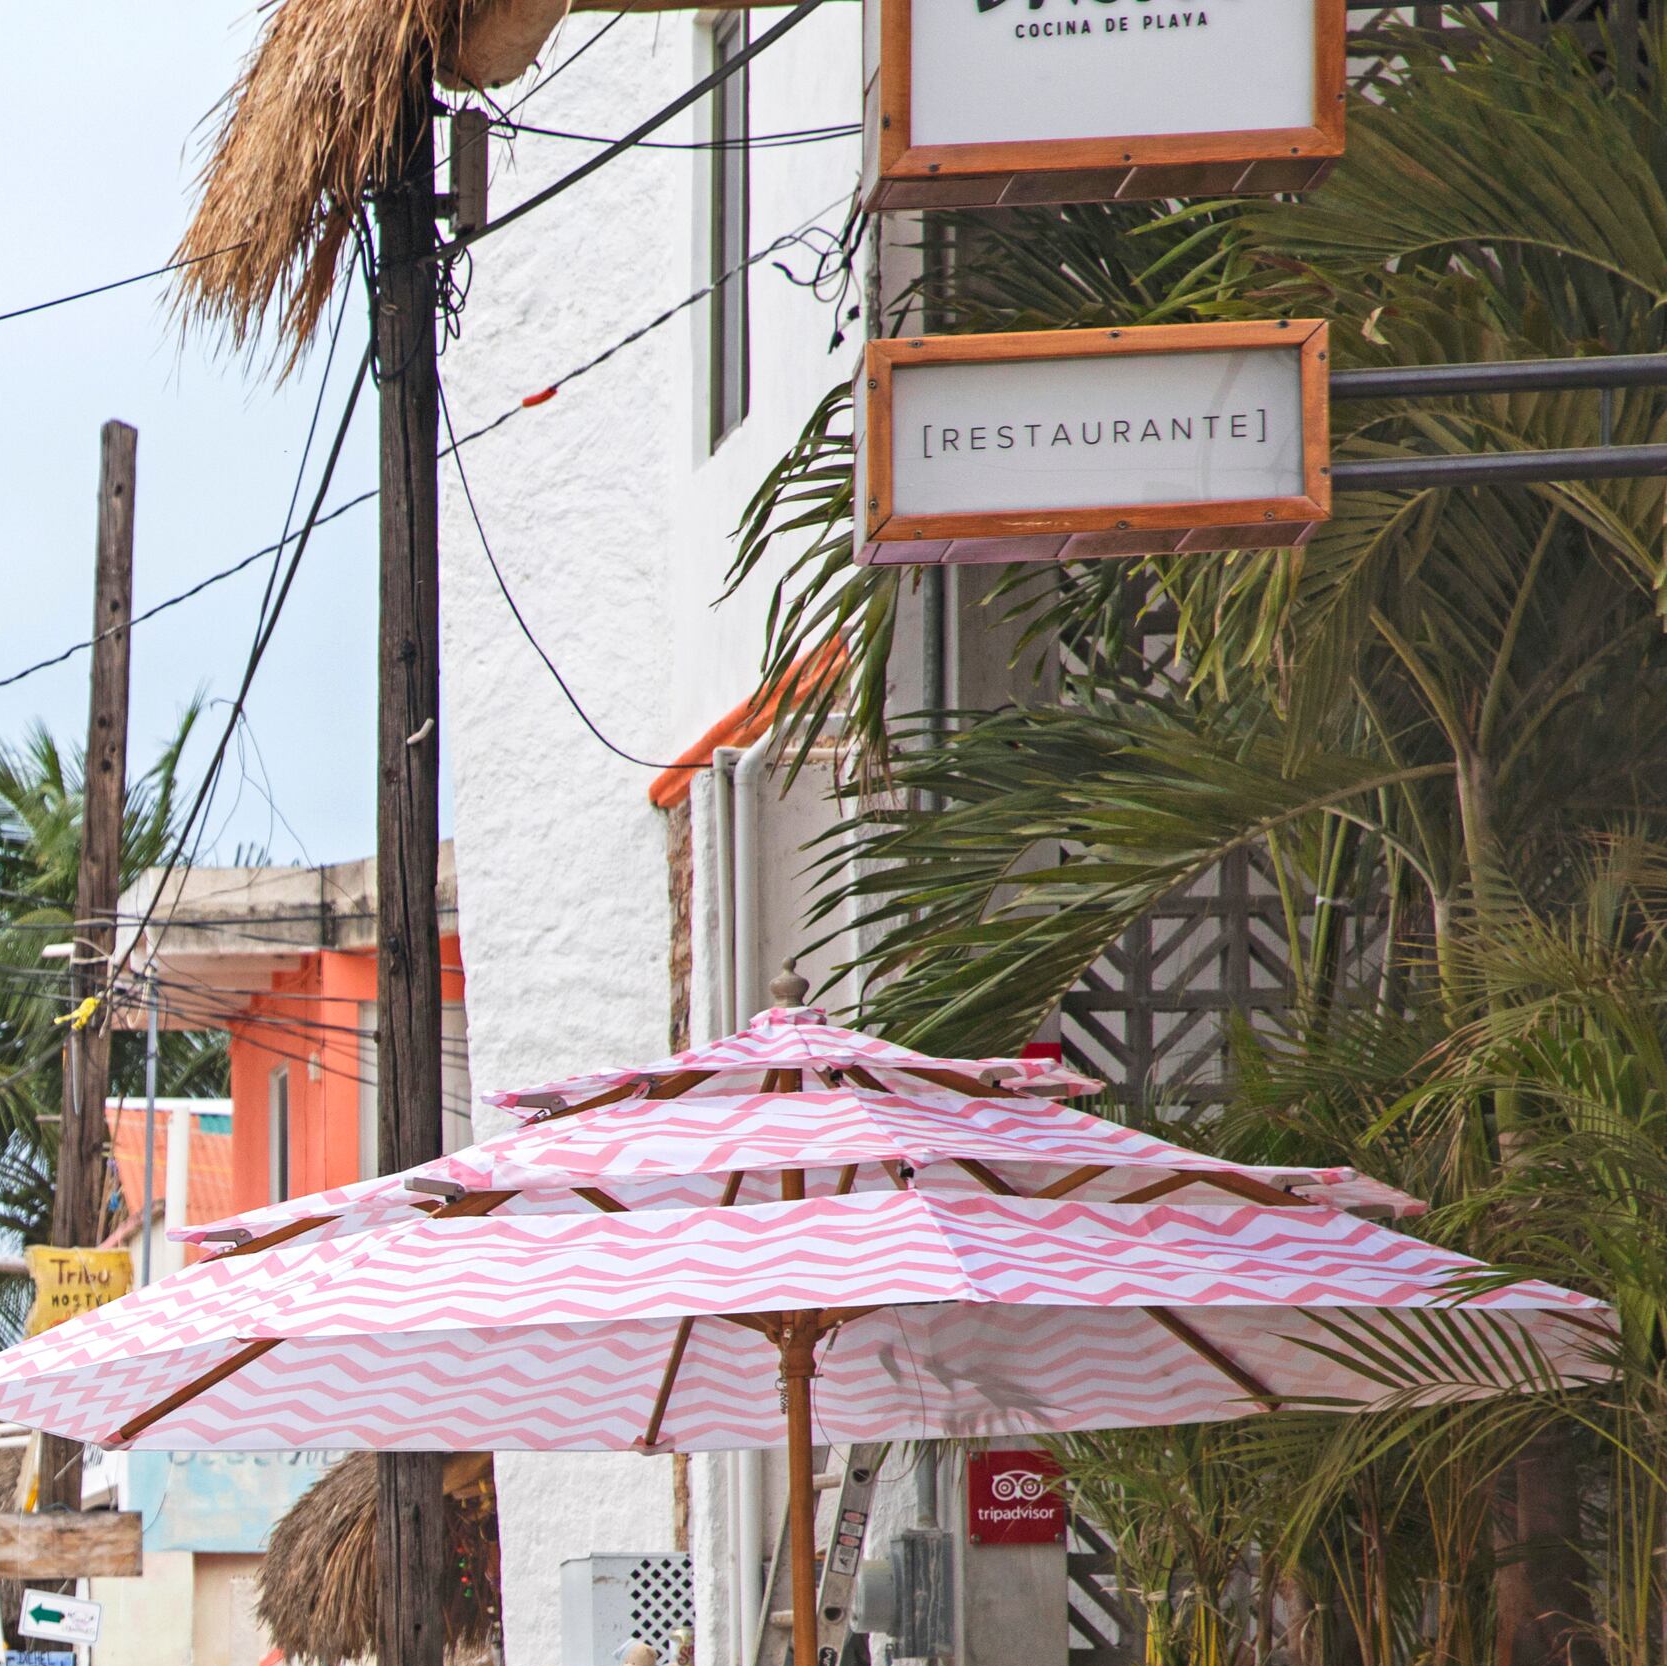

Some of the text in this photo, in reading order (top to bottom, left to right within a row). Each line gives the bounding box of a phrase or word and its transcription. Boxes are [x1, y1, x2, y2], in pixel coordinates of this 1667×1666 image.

[1015, 11, 1208, 39] COCINA DE PLAYA
[977, 1506, 1055, 1523] tripadvisor
